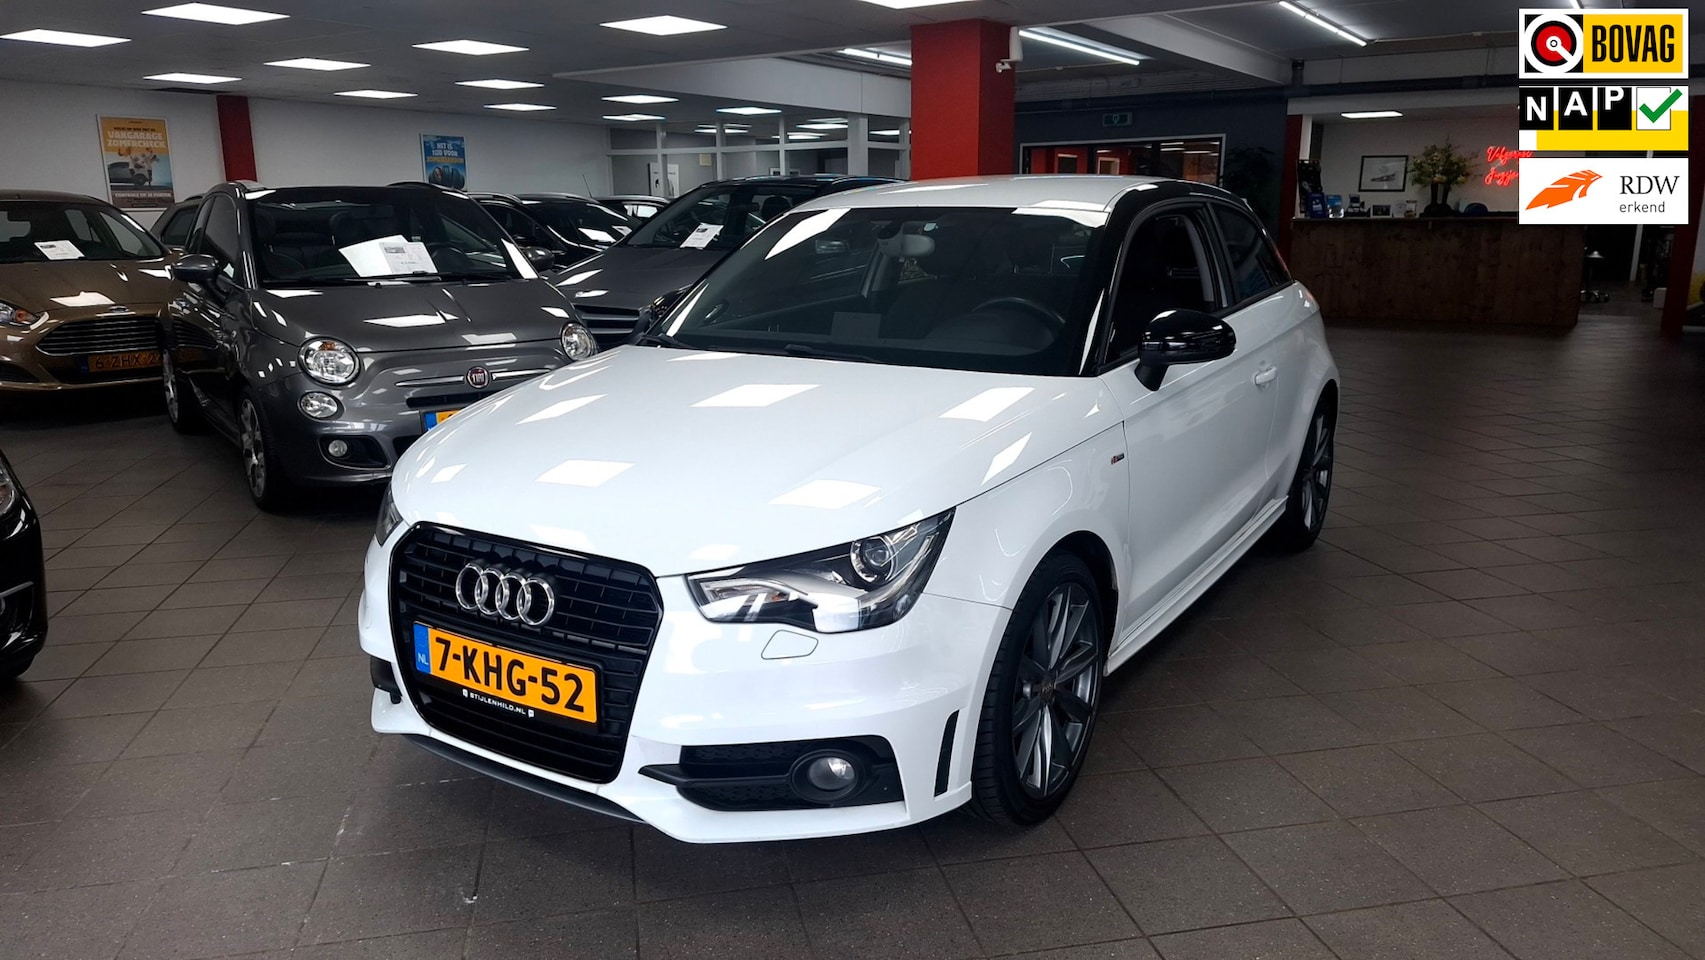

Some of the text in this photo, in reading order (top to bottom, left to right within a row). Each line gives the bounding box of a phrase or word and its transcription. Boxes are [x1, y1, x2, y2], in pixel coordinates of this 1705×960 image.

[107, 131, 163, 139] VAKGARAGE
[106, 139, 166, 148] ZOMERCHECK
[417, 652, 429, 665] NL
[435, 637, 584, 713] 7-KHG-52
[469, 692, 526, 715] STIJLENHILD.NL
